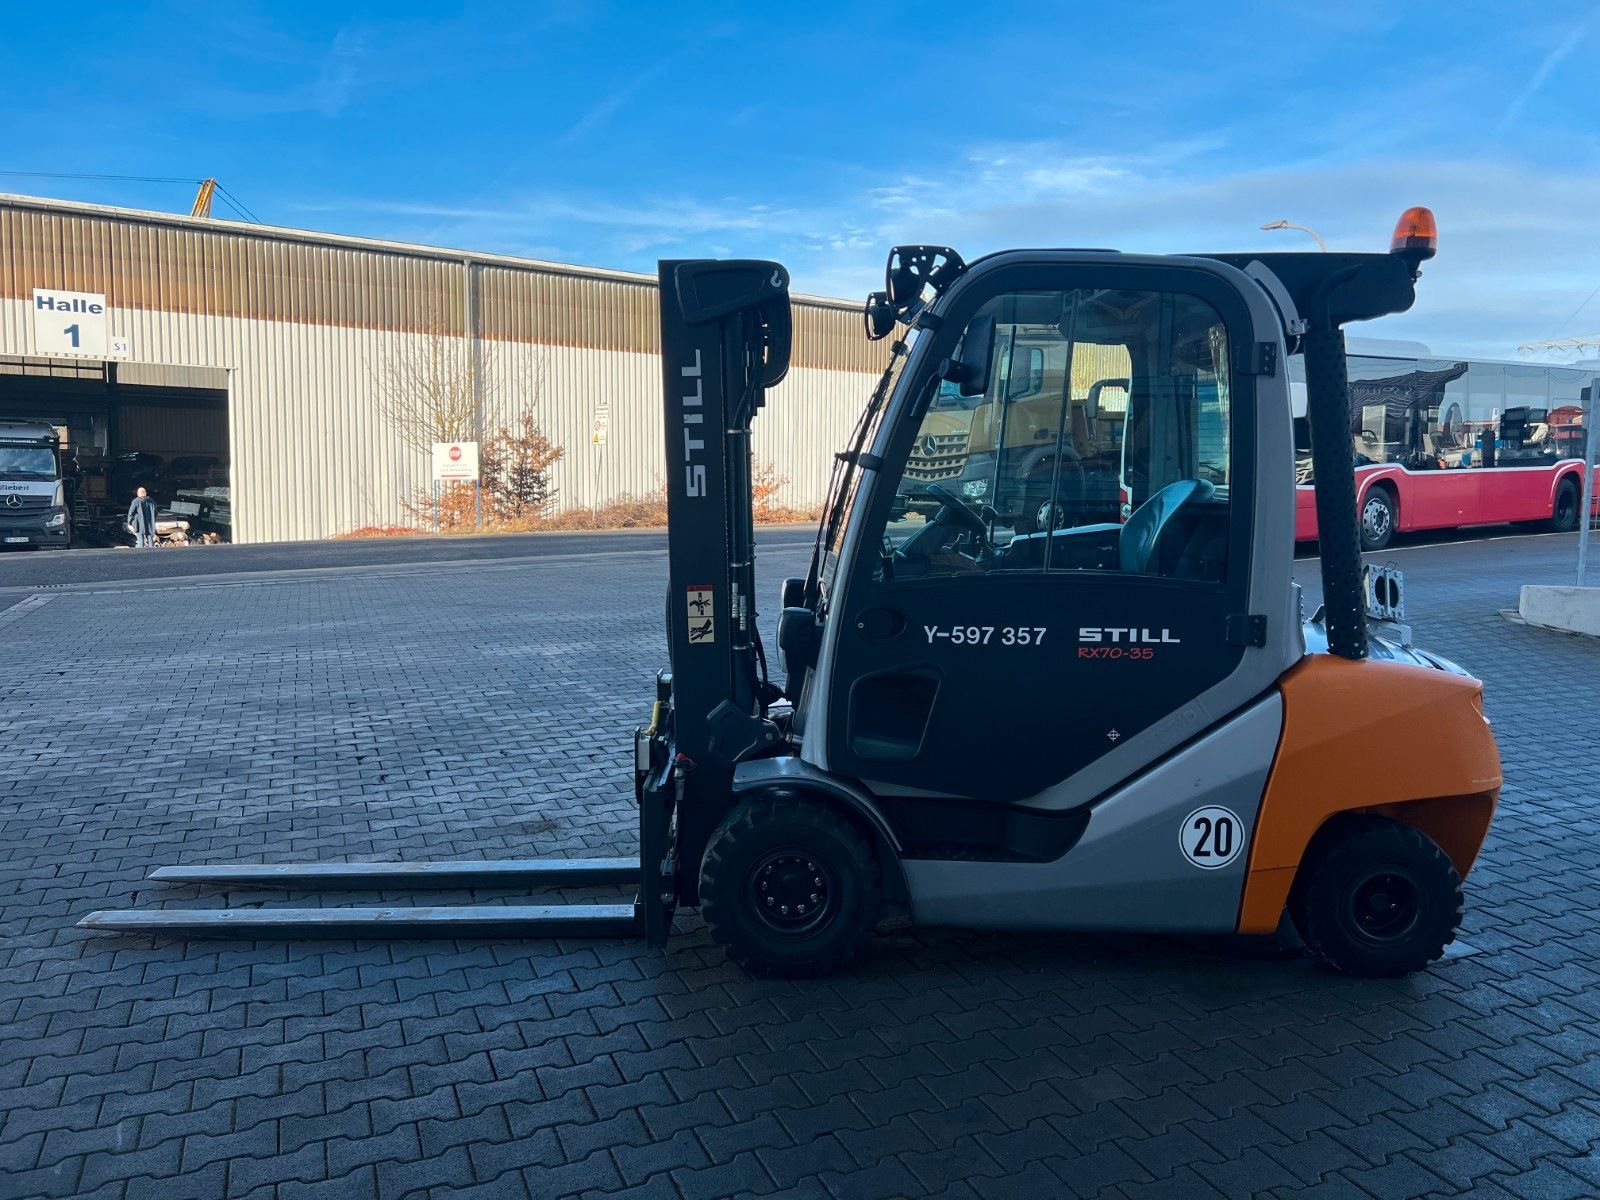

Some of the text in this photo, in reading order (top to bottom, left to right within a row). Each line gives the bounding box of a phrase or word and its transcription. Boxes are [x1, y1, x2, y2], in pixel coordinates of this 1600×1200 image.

[36, 295, 103, 315] Halle
[63, 324, 80, 348] 1
[681, 348, 707, 498] STILL
[923, 625, 1047, 646] Y-597 357
[1078, 627, 1181, 643] STILL
[1078, 646, 1154, 660] RX70-35
[1192, 816, 1233, 857] 20
